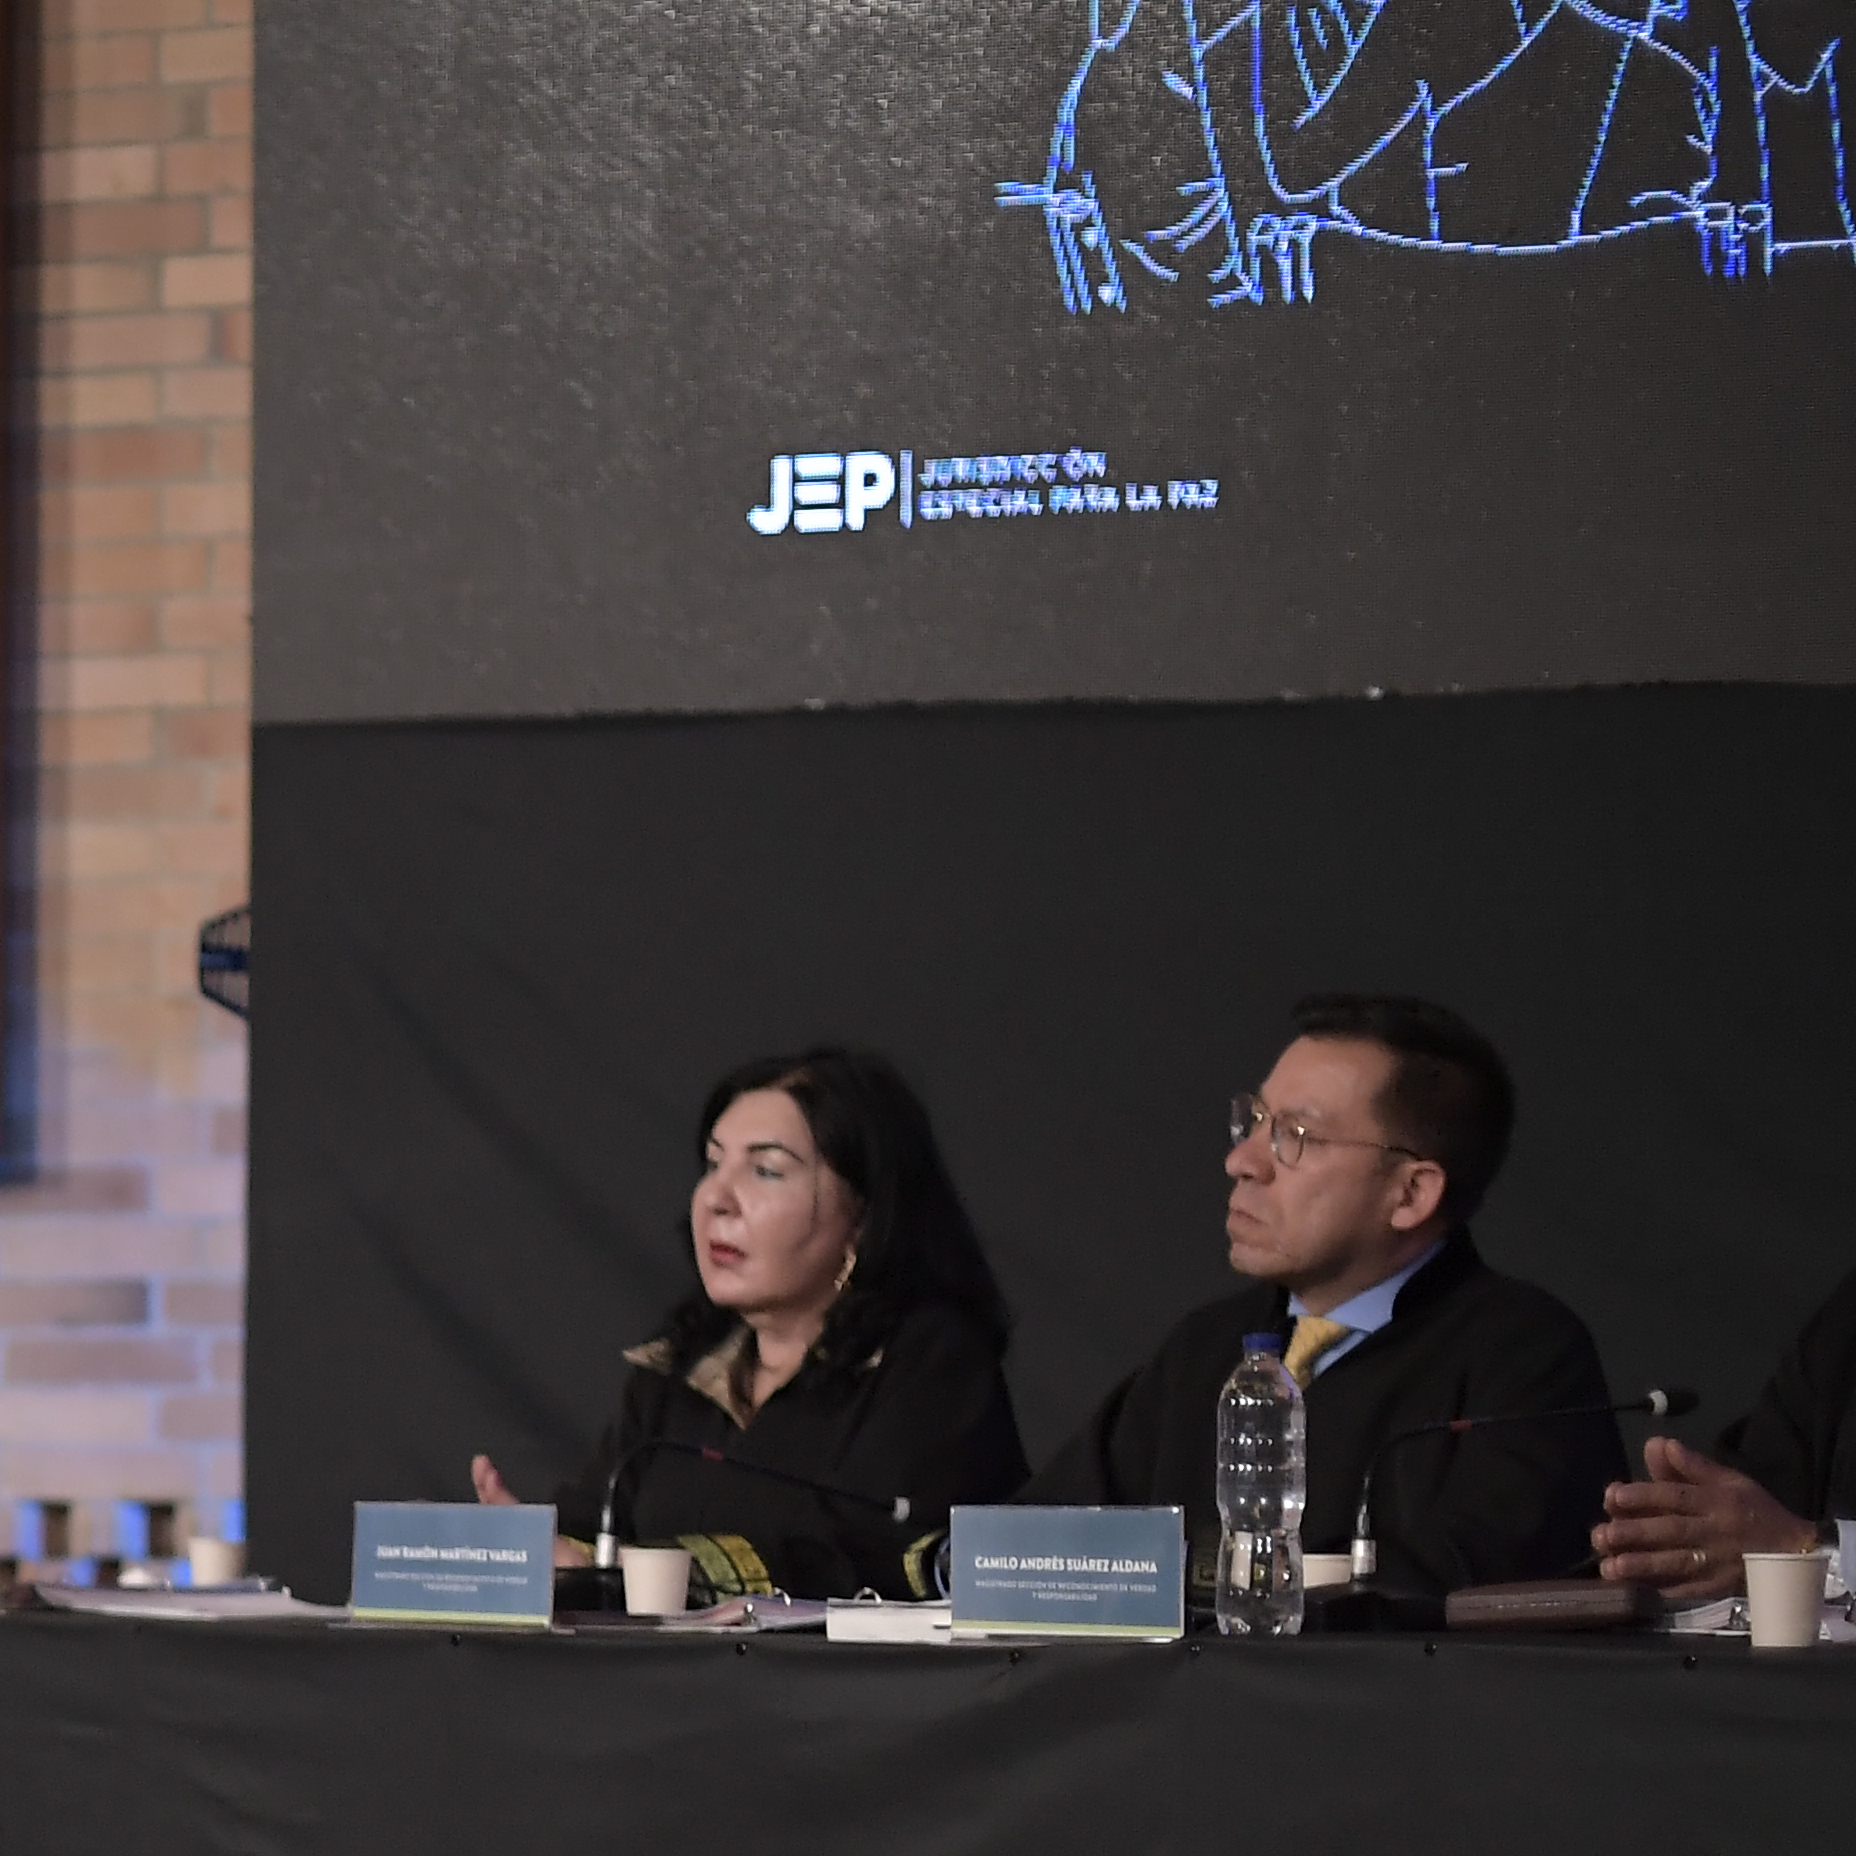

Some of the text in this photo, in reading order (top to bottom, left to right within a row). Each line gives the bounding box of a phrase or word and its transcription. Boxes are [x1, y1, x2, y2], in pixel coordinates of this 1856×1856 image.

[746, 449, 896, 536] JEP
[918, 479, 1219, 521] ESPECIAL PARA LA PAZ
[376, 1545, 401, 1559] JUAN
[974, 1554, 1158, 1574] CAMILO ANDRÉS SUÁREZ ALDANA
